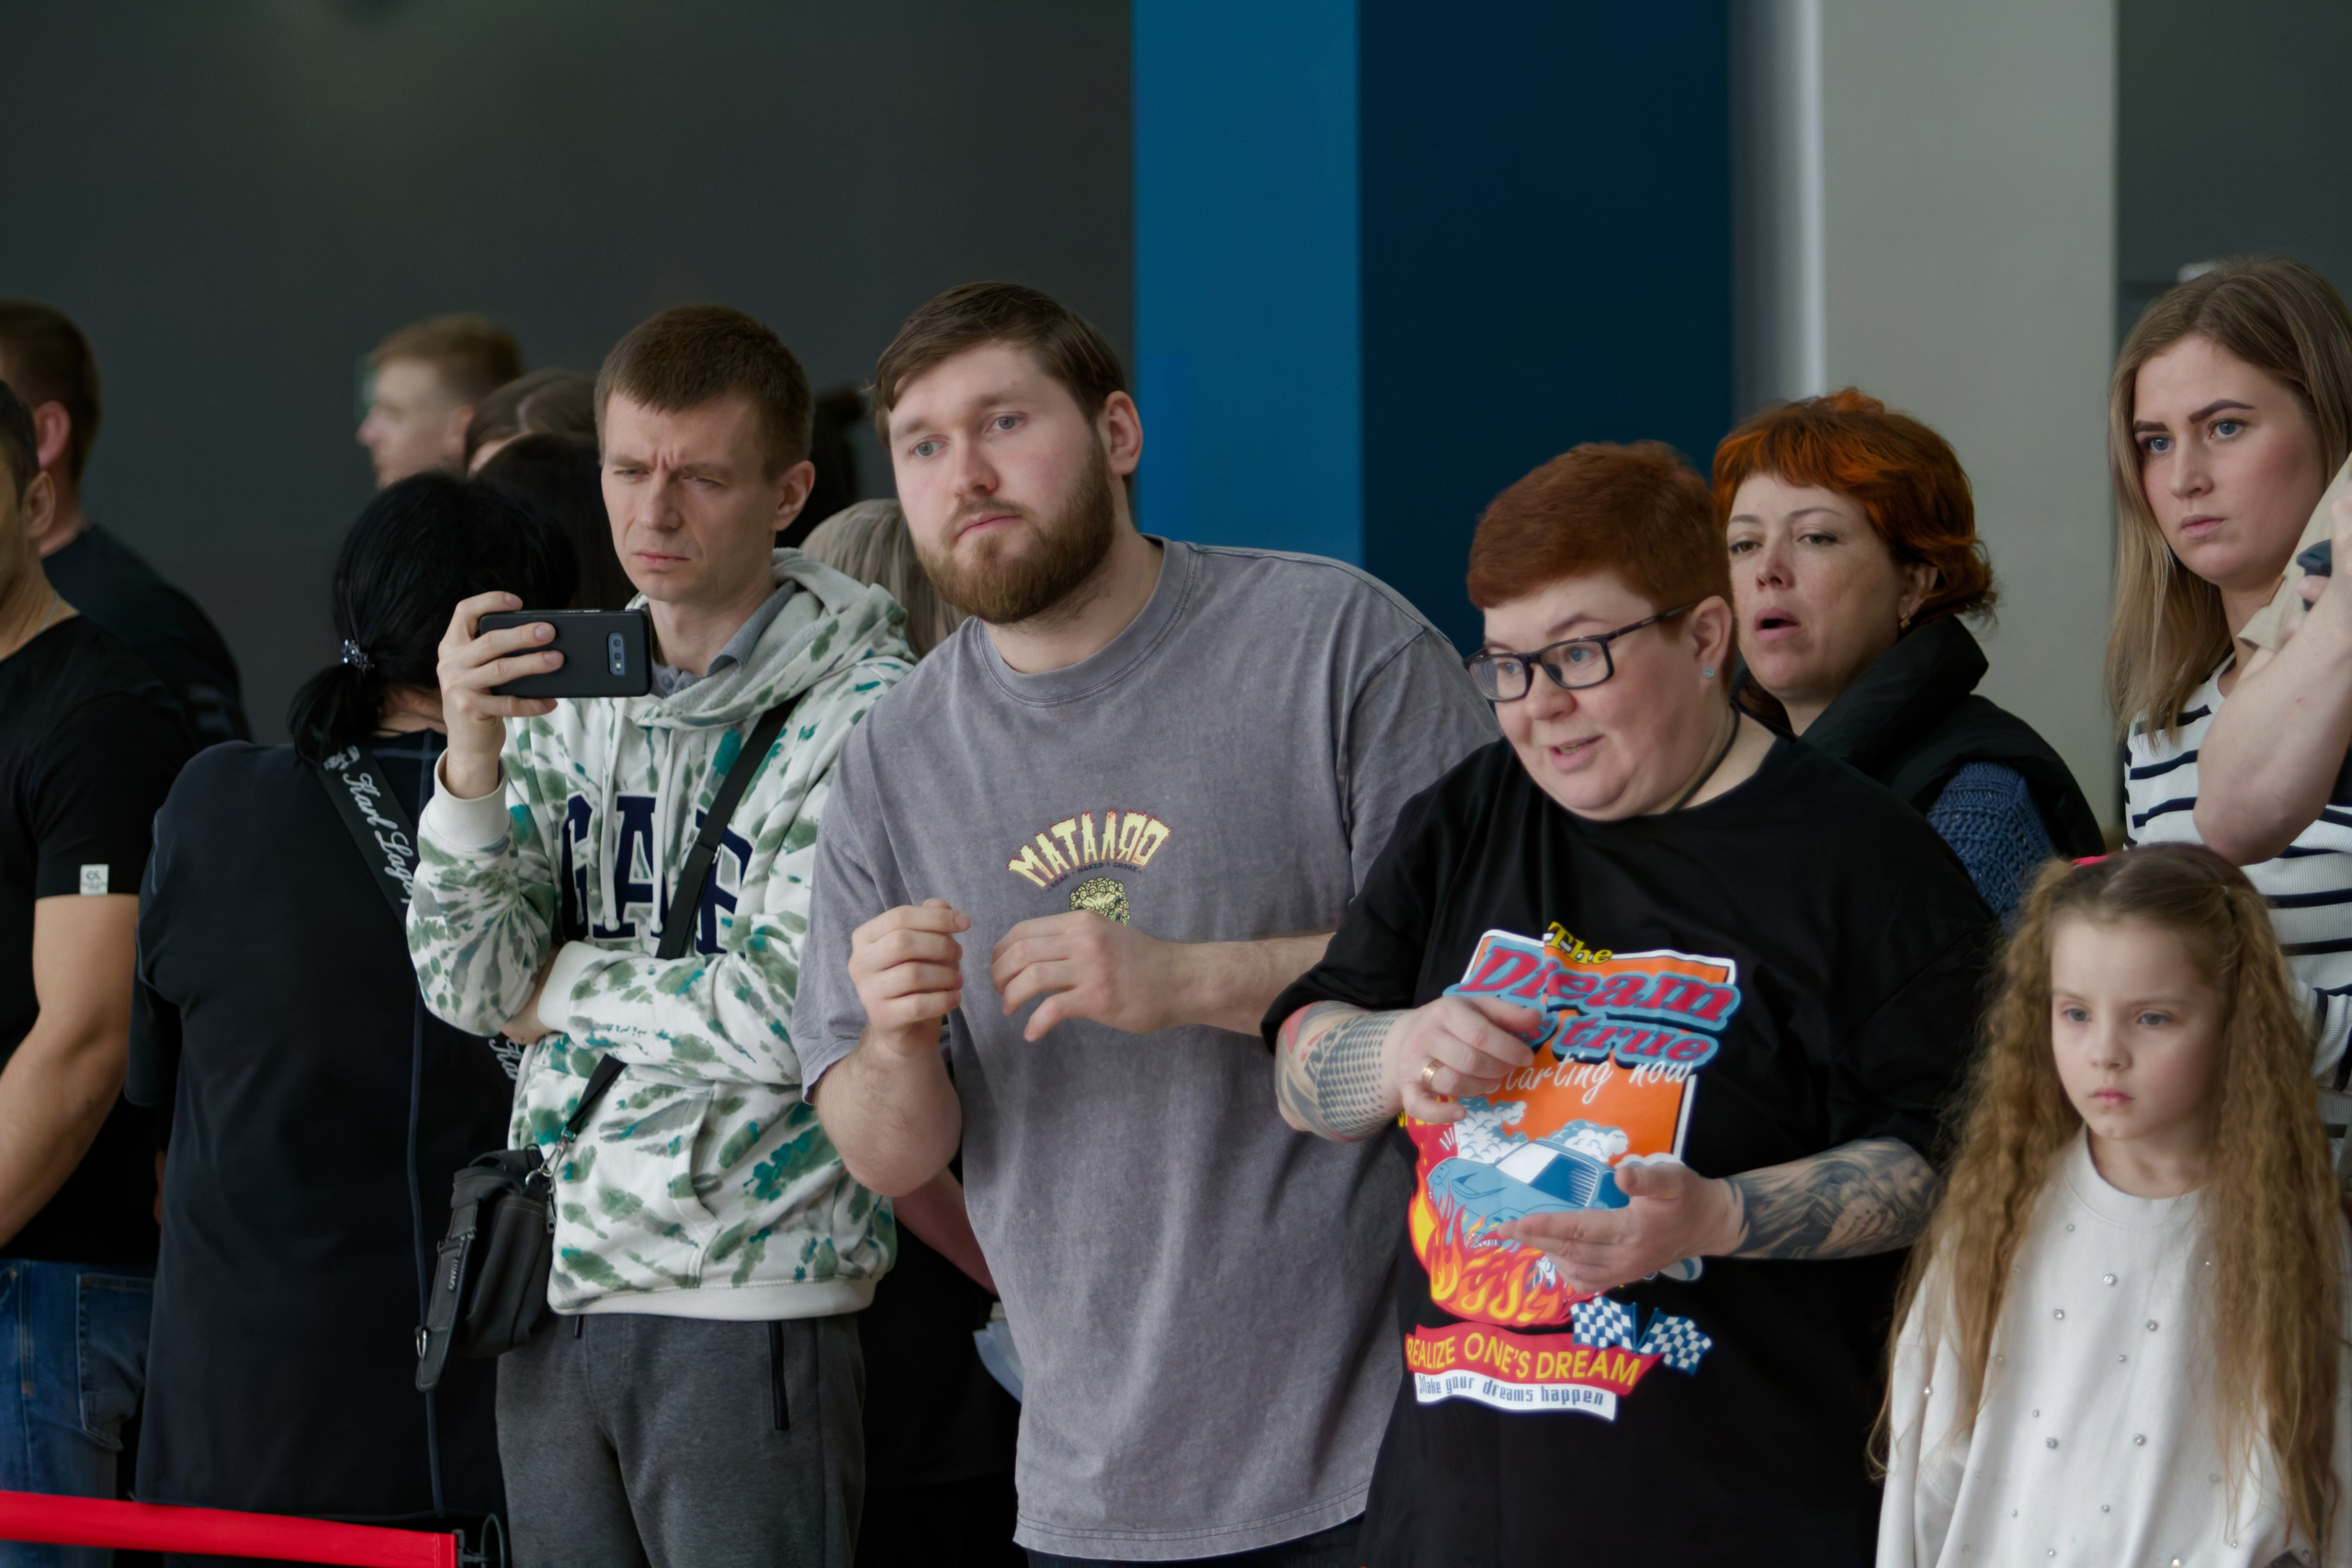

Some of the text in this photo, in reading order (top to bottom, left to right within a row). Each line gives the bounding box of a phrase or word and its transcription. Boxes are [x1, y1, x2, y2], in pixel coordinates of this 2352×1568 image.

[1546, 920, 1613, 965] The
[1559, 1017, 1711, 1061] true
[1485, 1051, 1694, 1105] tarting now
[1407, 1332, 1641, 1386] REALIZE ONE'S DREAM
[1419, 1374, 1604, 1405] Make your dreams happen
